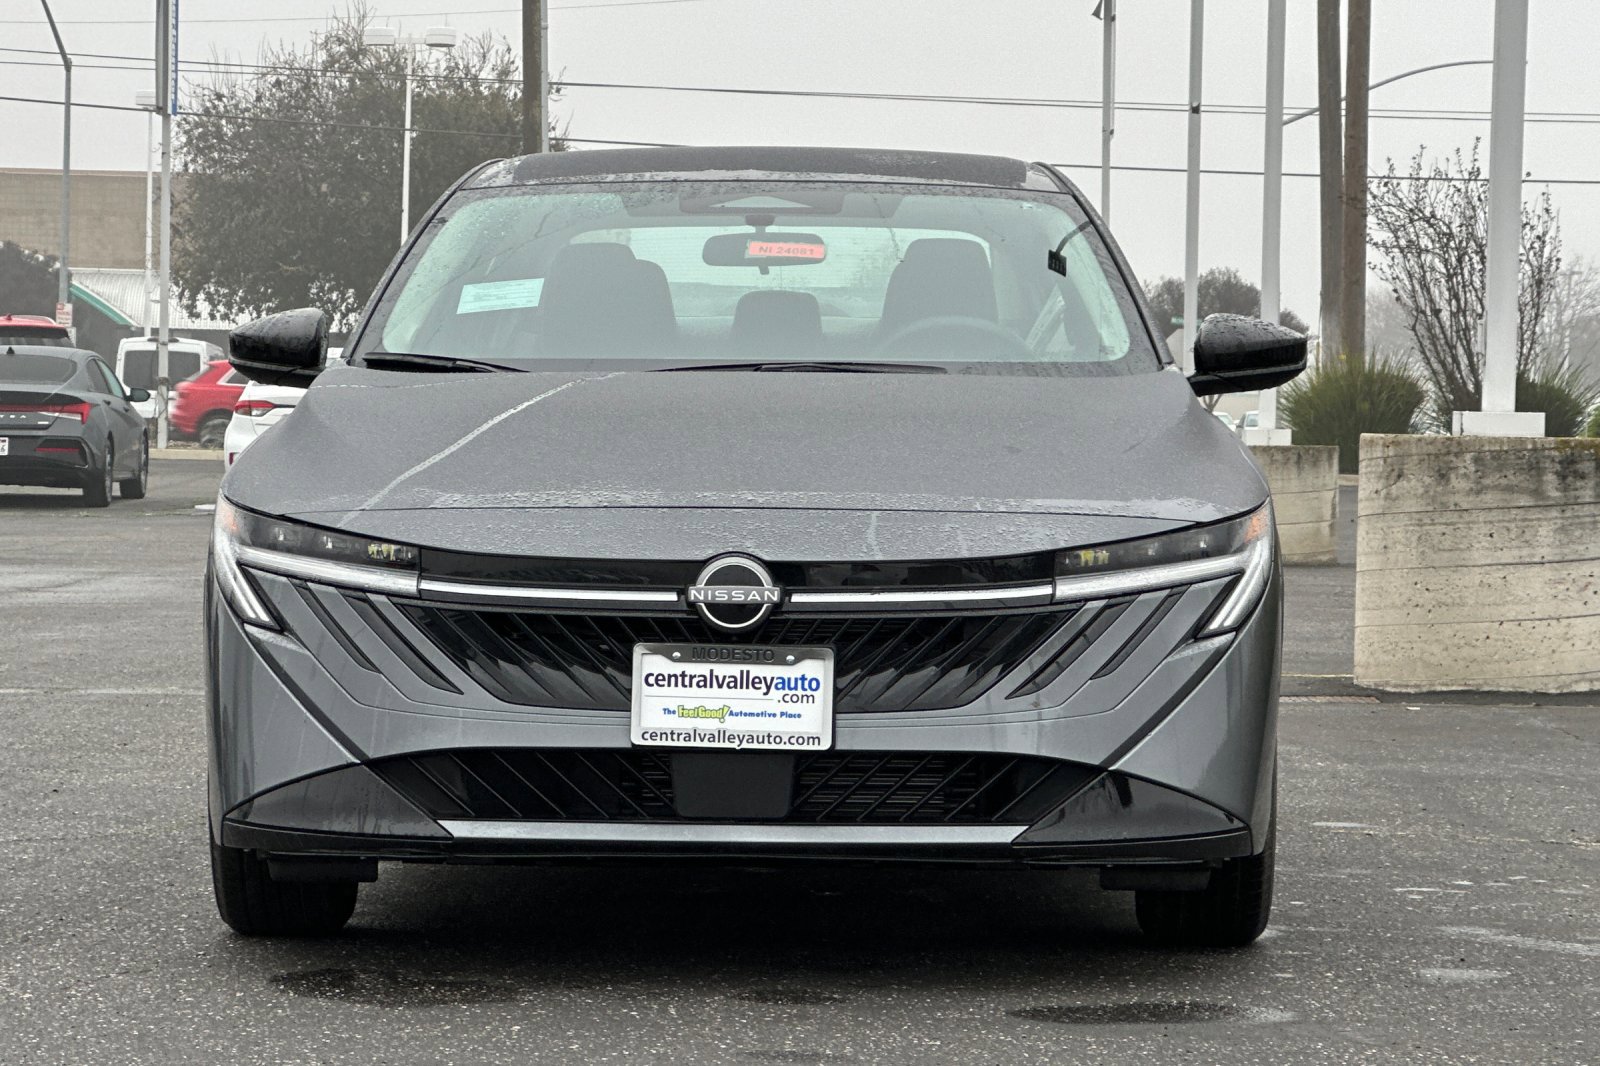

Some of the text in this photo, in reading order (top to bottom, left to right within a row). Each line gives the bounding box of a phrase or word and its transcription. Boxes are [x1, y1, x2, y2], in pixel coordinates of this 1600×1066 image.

[690, 590, 778, 601] NISSAN
[692, 647, 775, 662] MODESTO
[644, 669, 820, 696] centralvalleyauto
[777, 693, 815, 704] .com
[728, 710, 777, 719] Automotive
[780, 711, 802, 719] Place
[641, 729, 821, 747] centralvalleyauto.com
